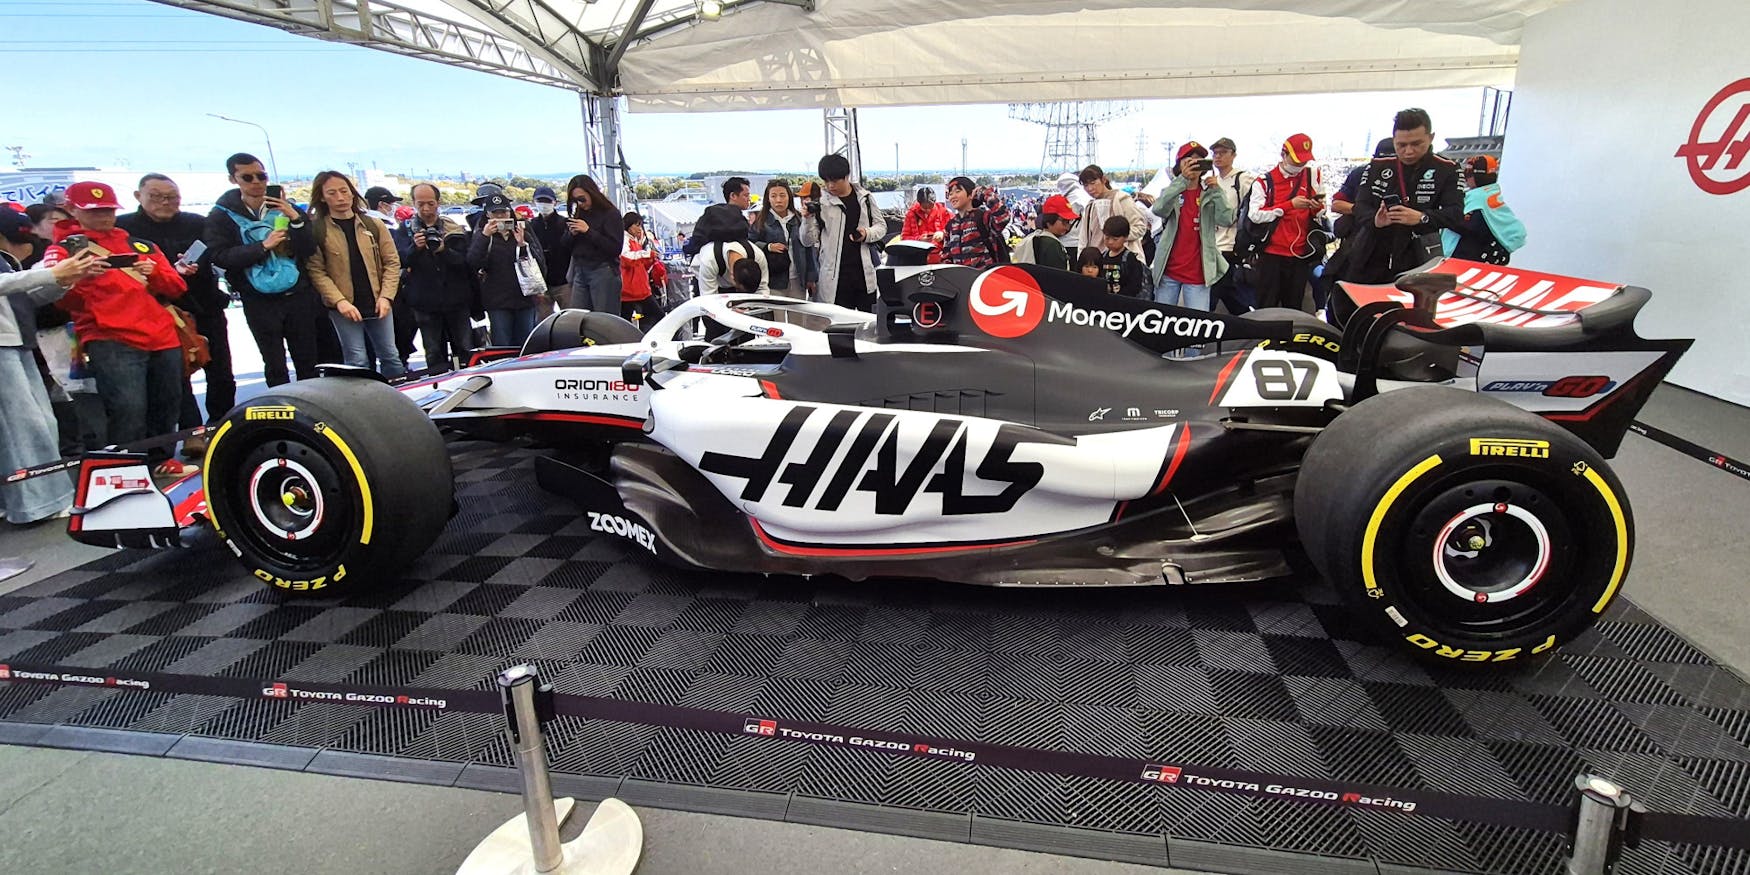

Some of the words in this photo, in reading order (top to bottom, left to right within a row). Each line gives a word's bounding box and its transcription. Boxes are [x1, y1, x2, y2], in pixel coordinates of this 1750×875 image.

[1047, 300, 1226, 339] MoneyGram
[1280, 333, 1341, 353] ERO
[1252, 359, 1320, 401] 87
[557, 393, 639, 402] INSURANCE
[245, 405, 296, 421] PIRELLI
[1469, 437, 1550, 459] PIRELLI
[698, 405, 1077, 516] HAAS
[587, 511, 657, 555] ZOOMEX
[254, 568, 328, 591] ZERO
[332, 563, 347, 583] P
[1405, 633, 1522, 663] ZERO
[1531, 634, 1556, 655] P
[12, 669, 59, 681] TOYOTA
[61, 673, 105, 684] GAZOO
[105, 676, 150, 689] Racing
[262, 685, 287, 698] GR
[290, 688, 342, 700] TOYOTA
[345, 692, 395, 703] GAZOO
[396, 695, 447, 708] Racing
[745, 722, 776, 736] GR
[779, 727, 844, 744] TOYOTA
[849, 736, 910, 751] GAZOO
[914, 743, 976, 761] Racing
[1143, 768, 1178, 784] GR
[1184, 773, 1259, 792] TOYOTA
[1265, 784, 1338, 801] GAZOO
[1342, 791, 1417, 812] Racing
